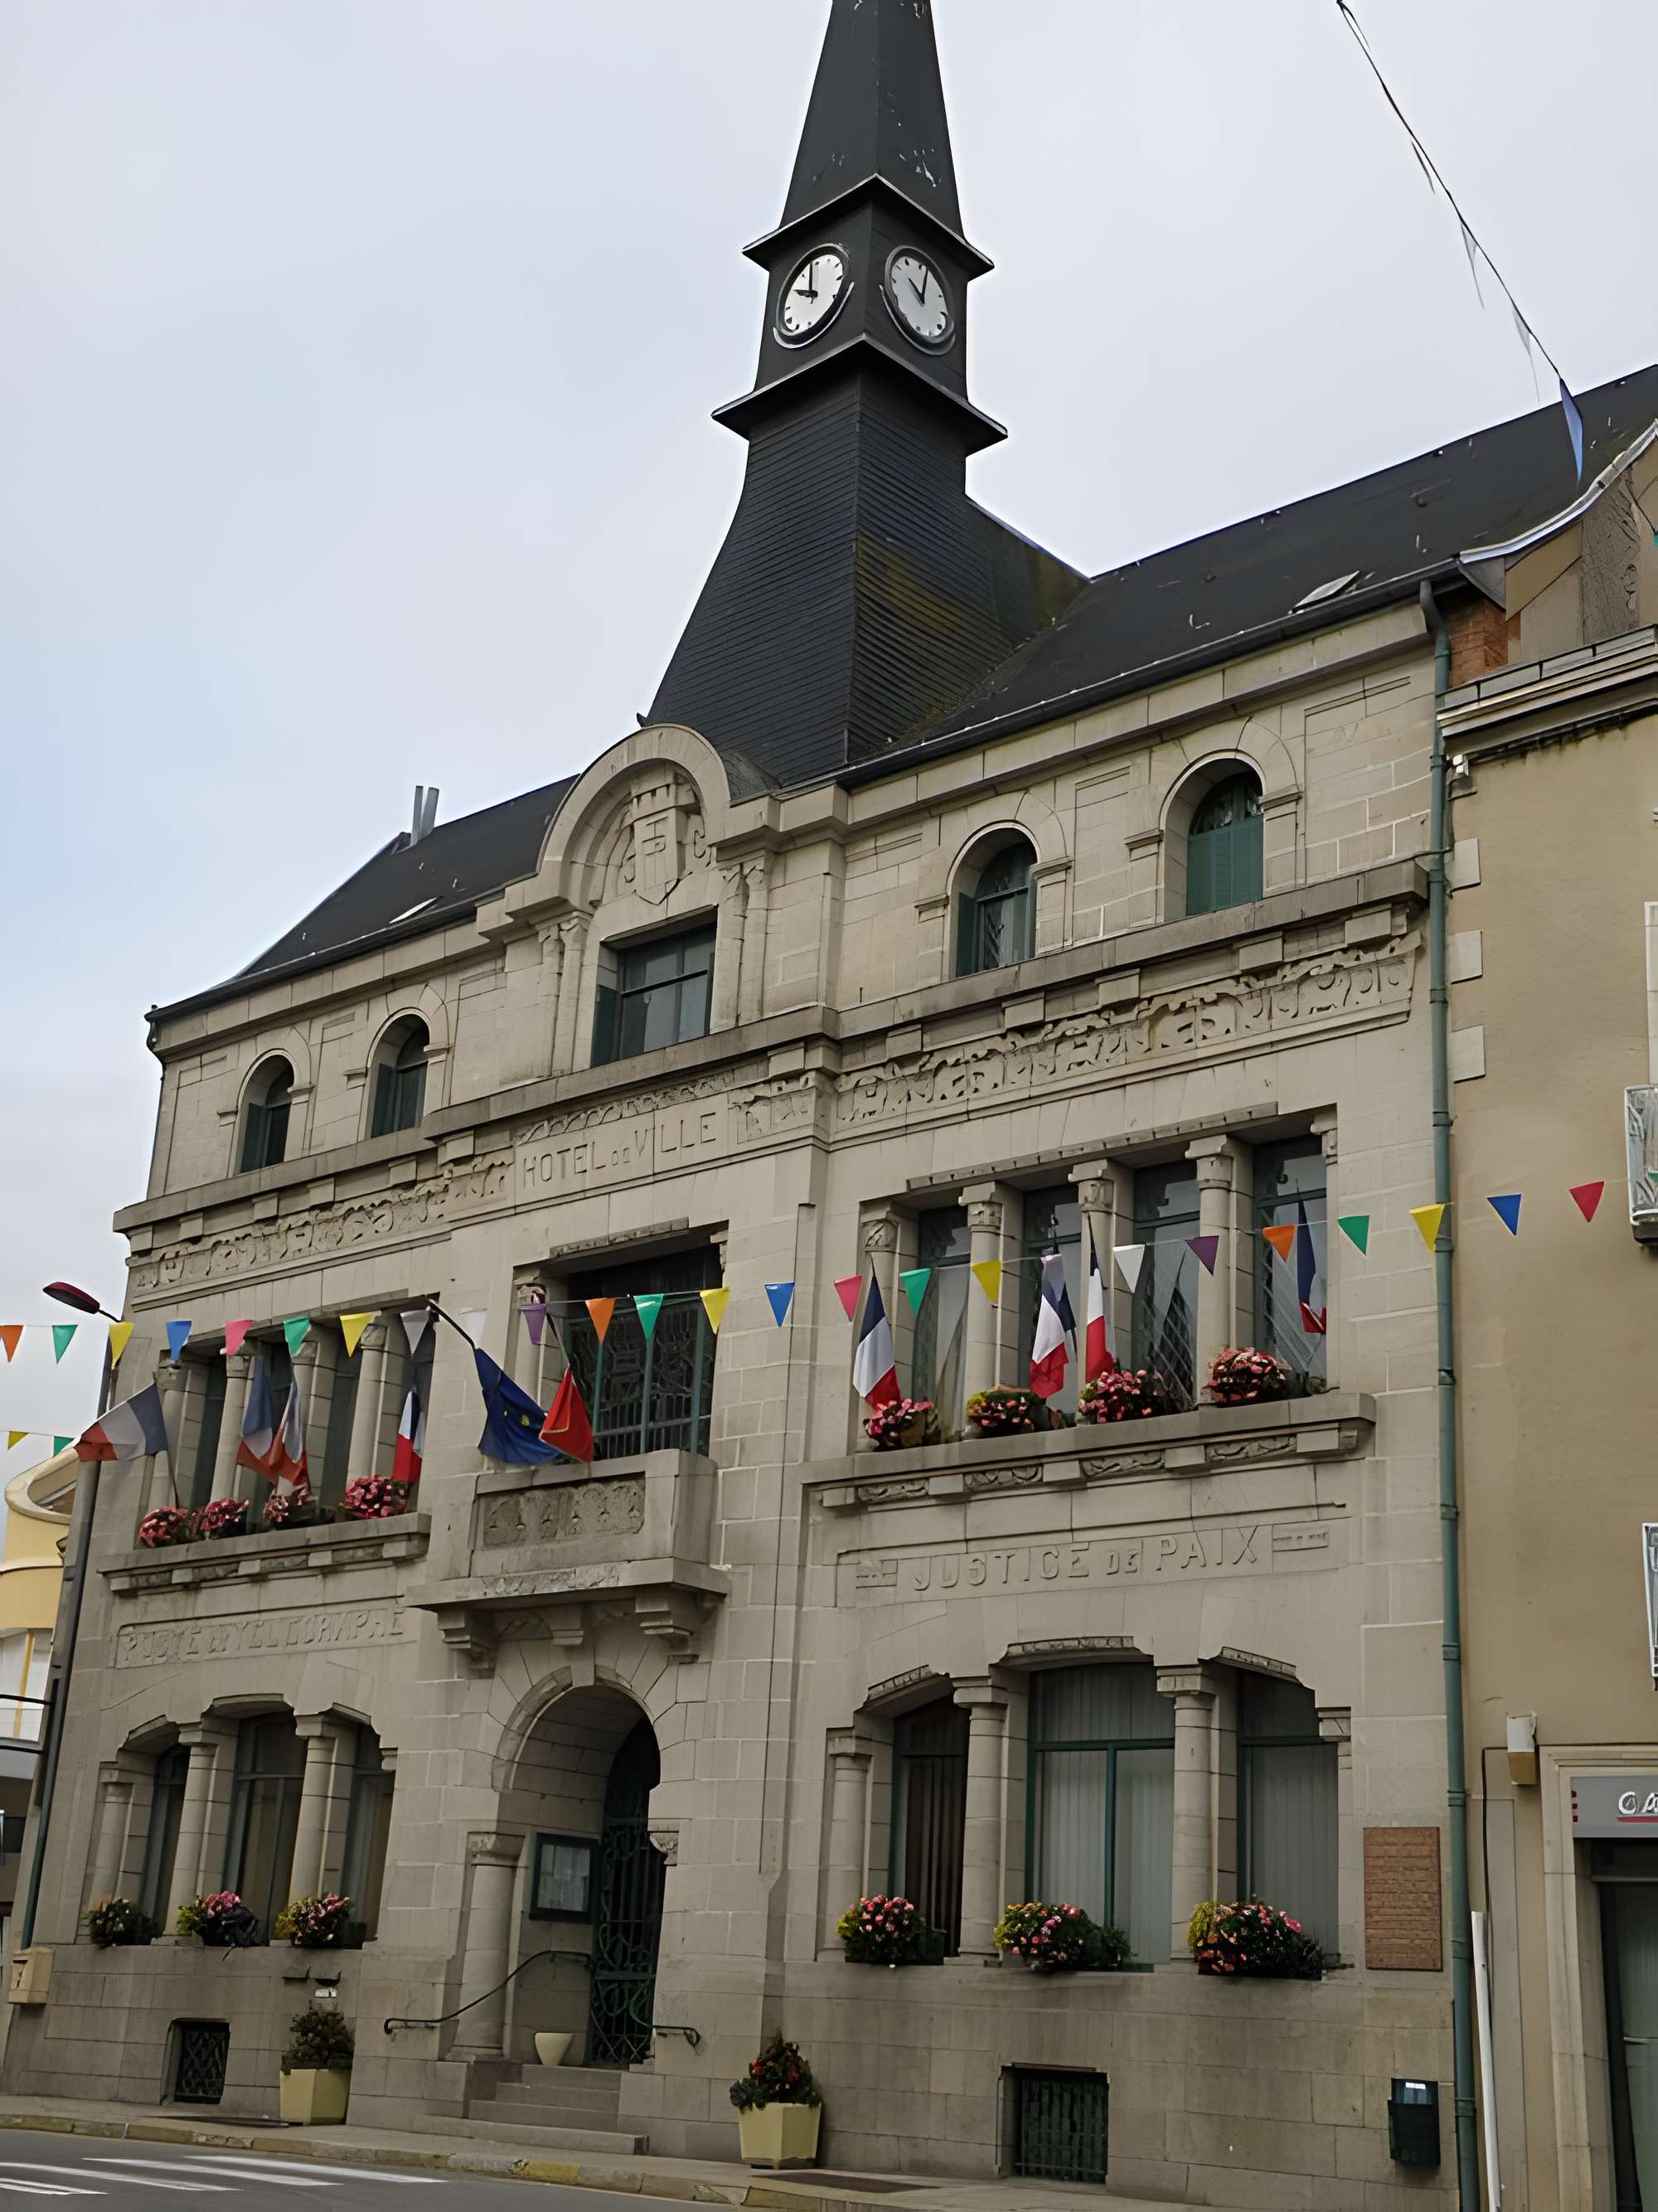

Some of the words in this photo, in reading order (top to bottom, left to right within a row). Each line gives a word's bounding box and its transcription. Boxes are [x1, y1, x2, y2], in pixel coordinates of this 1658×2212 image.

[523, 1141, 606, 1188] HOTEL
[634, 1112, 716, 1157] VILLE
[913, 1542, 1090, 1592] JUSTICE
[1155, 1525, 1258, 1572] PAIX
